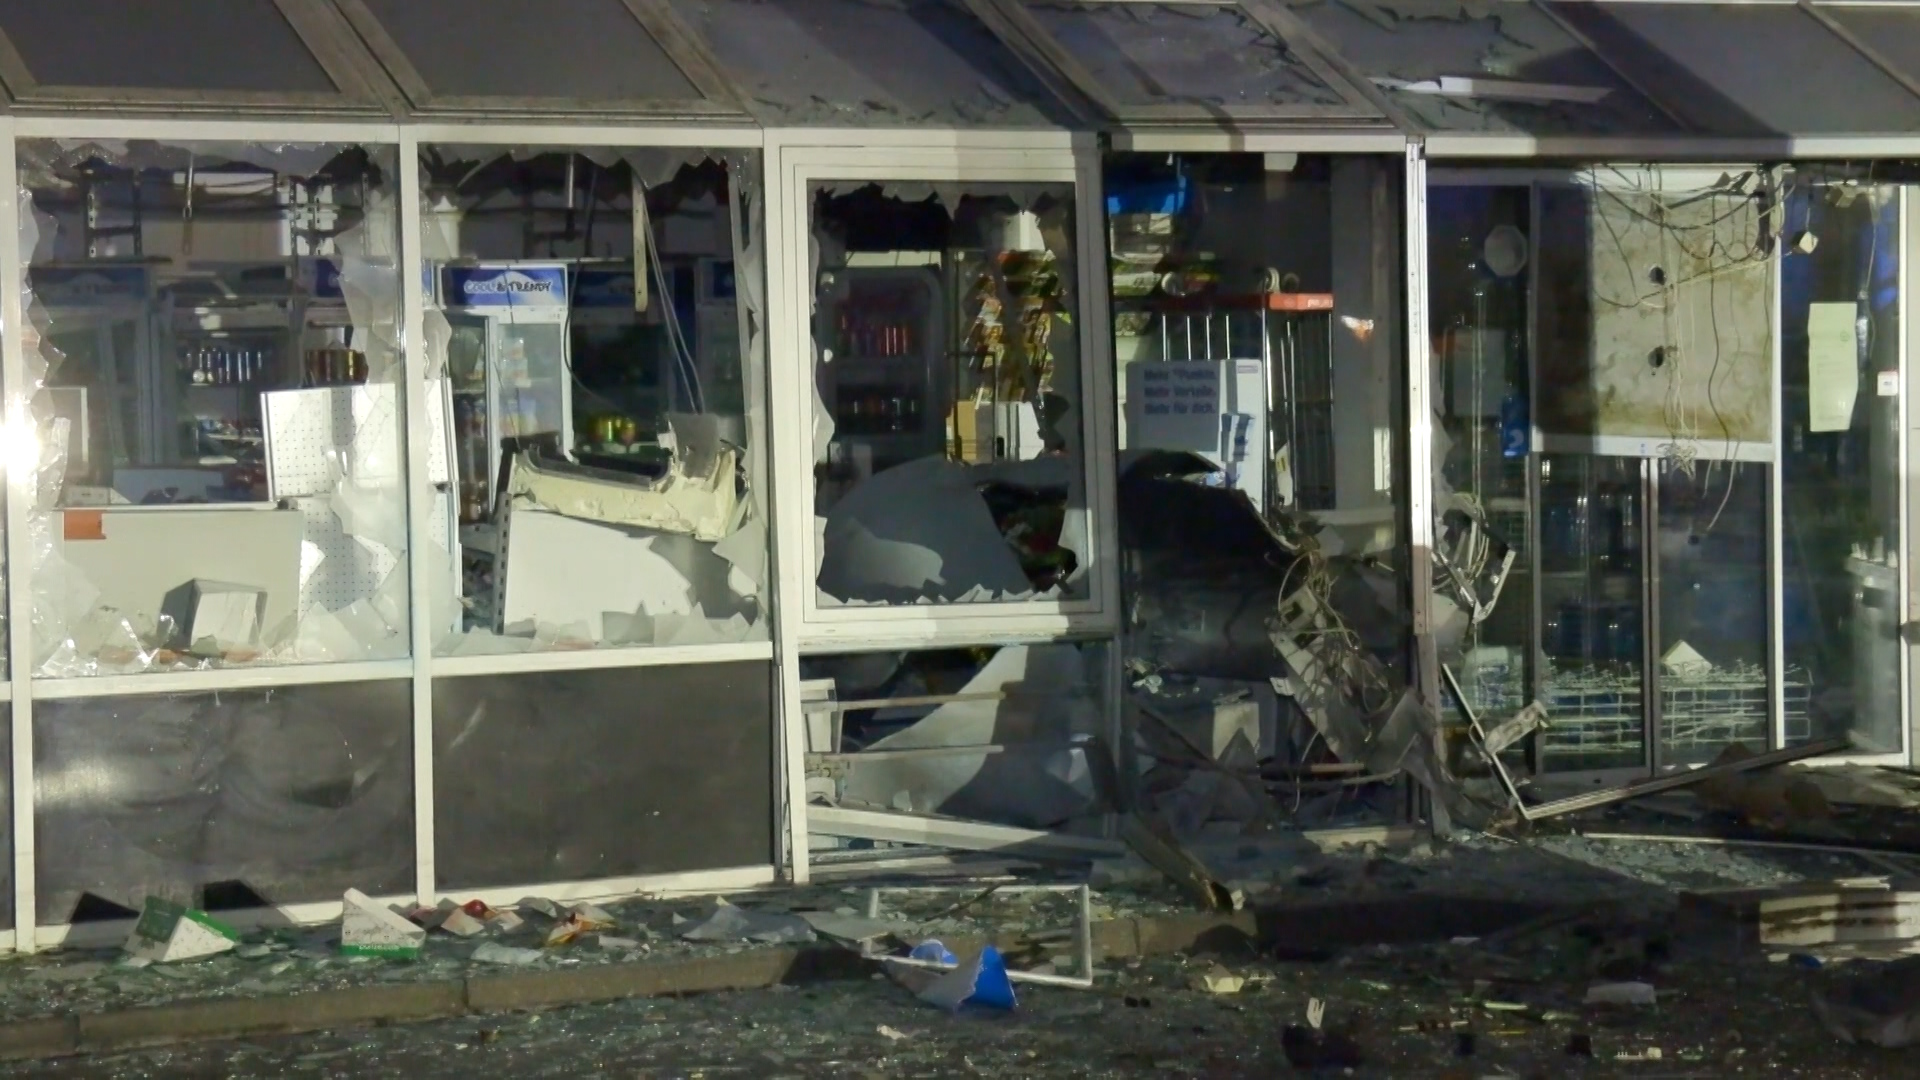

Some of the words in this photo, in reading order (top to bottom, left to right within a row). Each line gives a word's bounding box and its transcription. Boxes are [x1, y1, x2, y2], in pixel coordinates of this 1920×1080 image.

[464, 281, 496, 293] COOL
[497, 282, 506, 292] &
[508, 281, 552, 292] TRENDY
